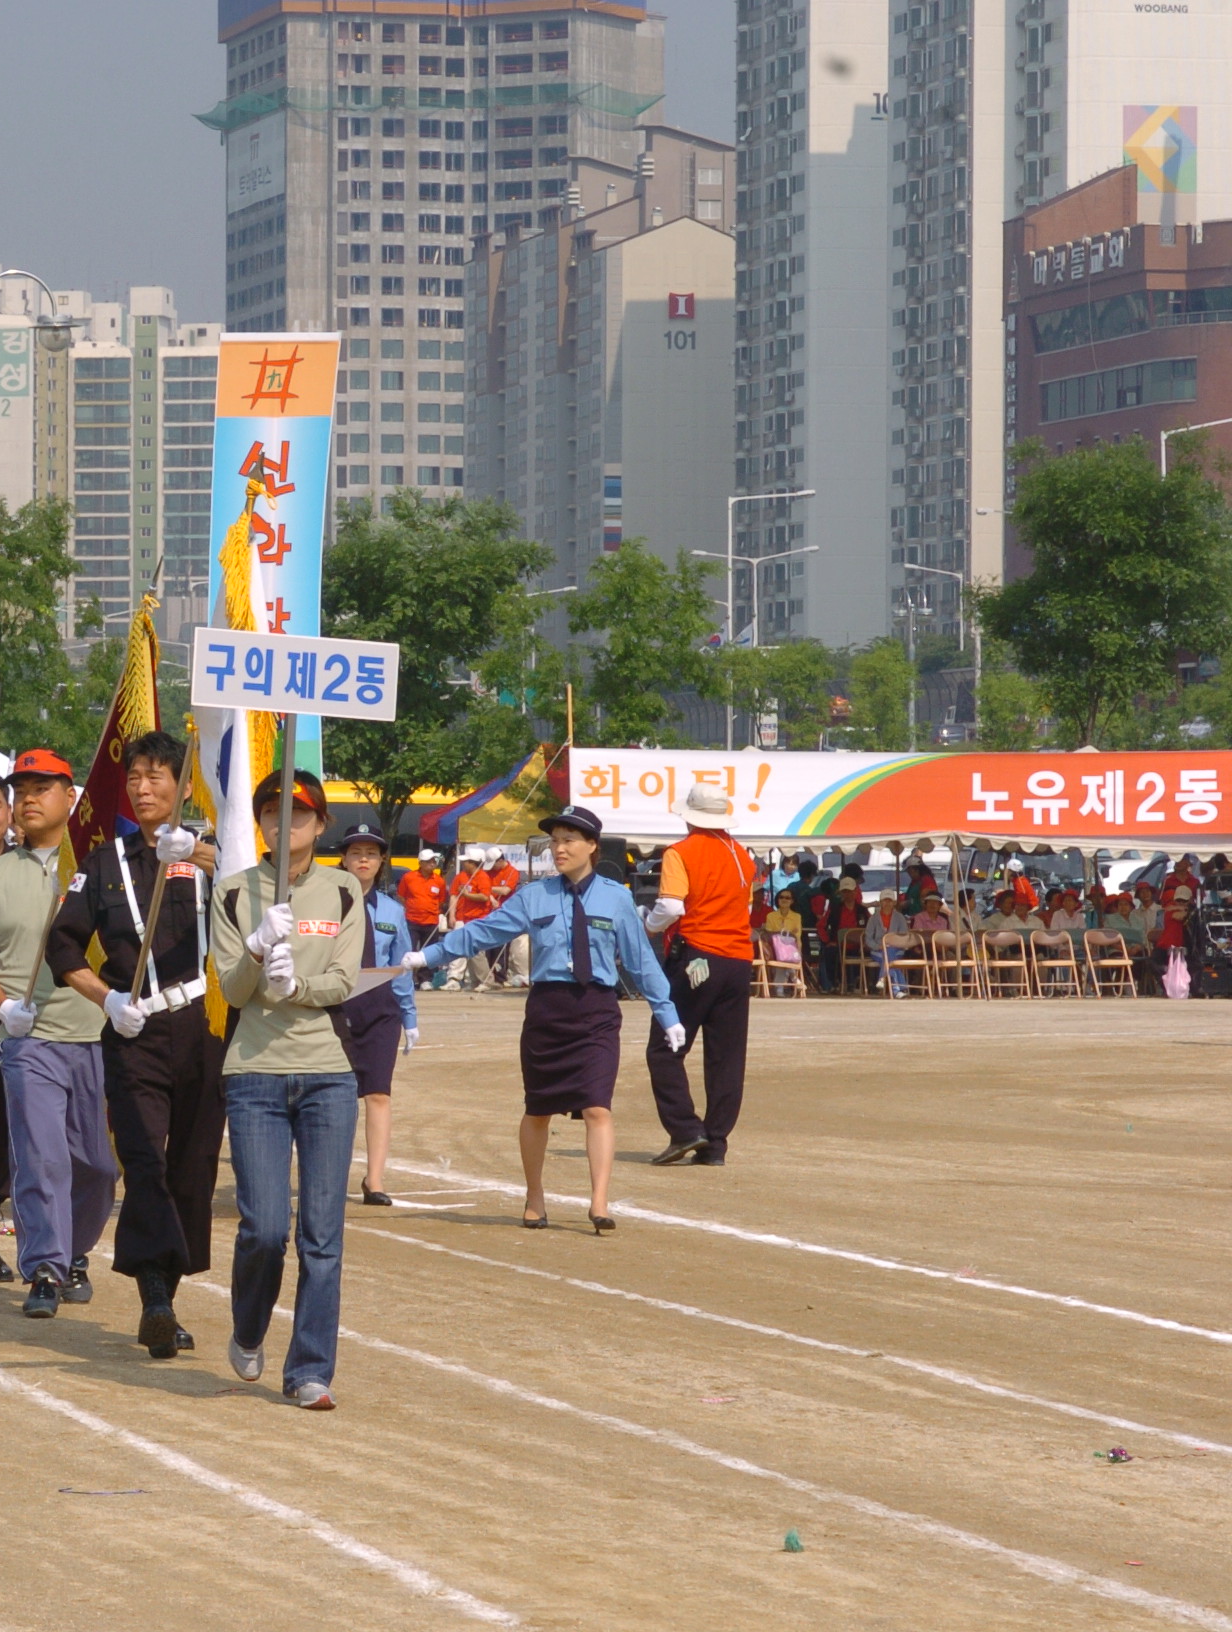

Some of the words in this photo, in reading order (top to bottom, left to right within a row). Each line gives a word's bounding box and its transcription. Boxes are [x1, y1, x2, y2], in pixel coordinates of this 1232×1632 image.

[1134, 4, 1189, 13] WOOBANG
[1033, 235, 1124, 285] 머릿돌교회
[663, 330, 696, 350] 101
[967, 769, 1223, 825] 노유제2동
